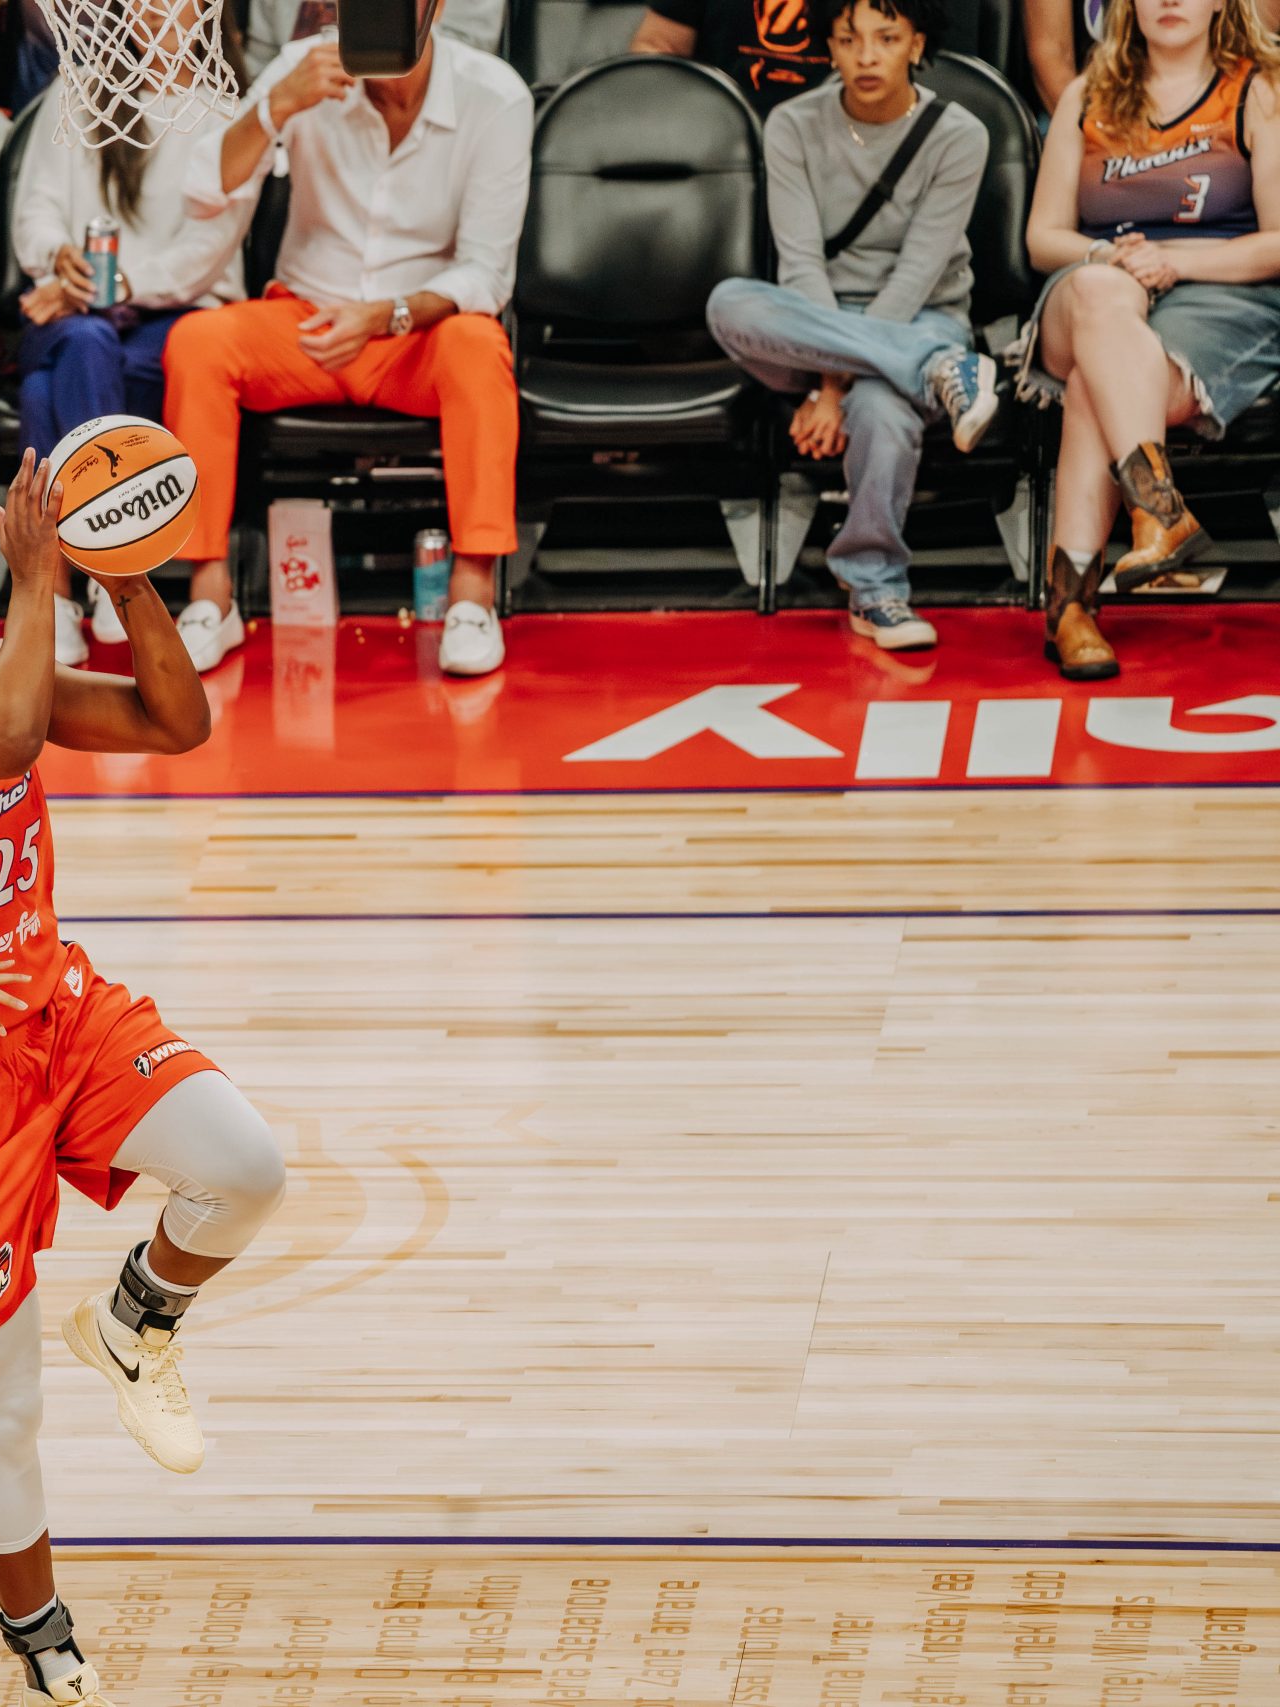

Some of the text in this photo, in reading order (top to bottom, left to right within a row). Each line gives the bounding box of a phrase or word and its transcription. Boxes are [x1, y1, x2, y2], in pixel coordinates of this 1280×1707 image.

[1103, 136, 1211, 184] Phoenix
[1173, 173, 1211, 223] 3
[84, 473, 185, 533] Wilson
[63, 965, 81, 988] NIKE
[149, 1041, 193, 1062] WNB
[98, 1572, 171, 1636] Ragland
[372, 1569, 434, 1610] Scott
[460, 1575, 520, 1621] Smith
[633, 1580, 700, 1643] Tamane
[914, 1568, 976, 1603] Veal
[1002, 1570, 1066, 1616] Webb
[181, 1580, 255, 1655] Robinson
[540, 1578, 611, 1663] Stepanova
[719, 1607, 784, 1670] Thomas
[812, 1612, 874, 1664] Turner
[904, 1607, 968, 1664] Kristen
[1090, 1595, 1155, 1663] Williams
[264, 1616, 333, 1680] Sanford
[354, 1616, 429, 1679] Olympia
[624, 1649, 684, 1687] Zane
[995, 1621, 1059, 1672] Umeki
[1180, 1607, 1257, 1697] Willingham
